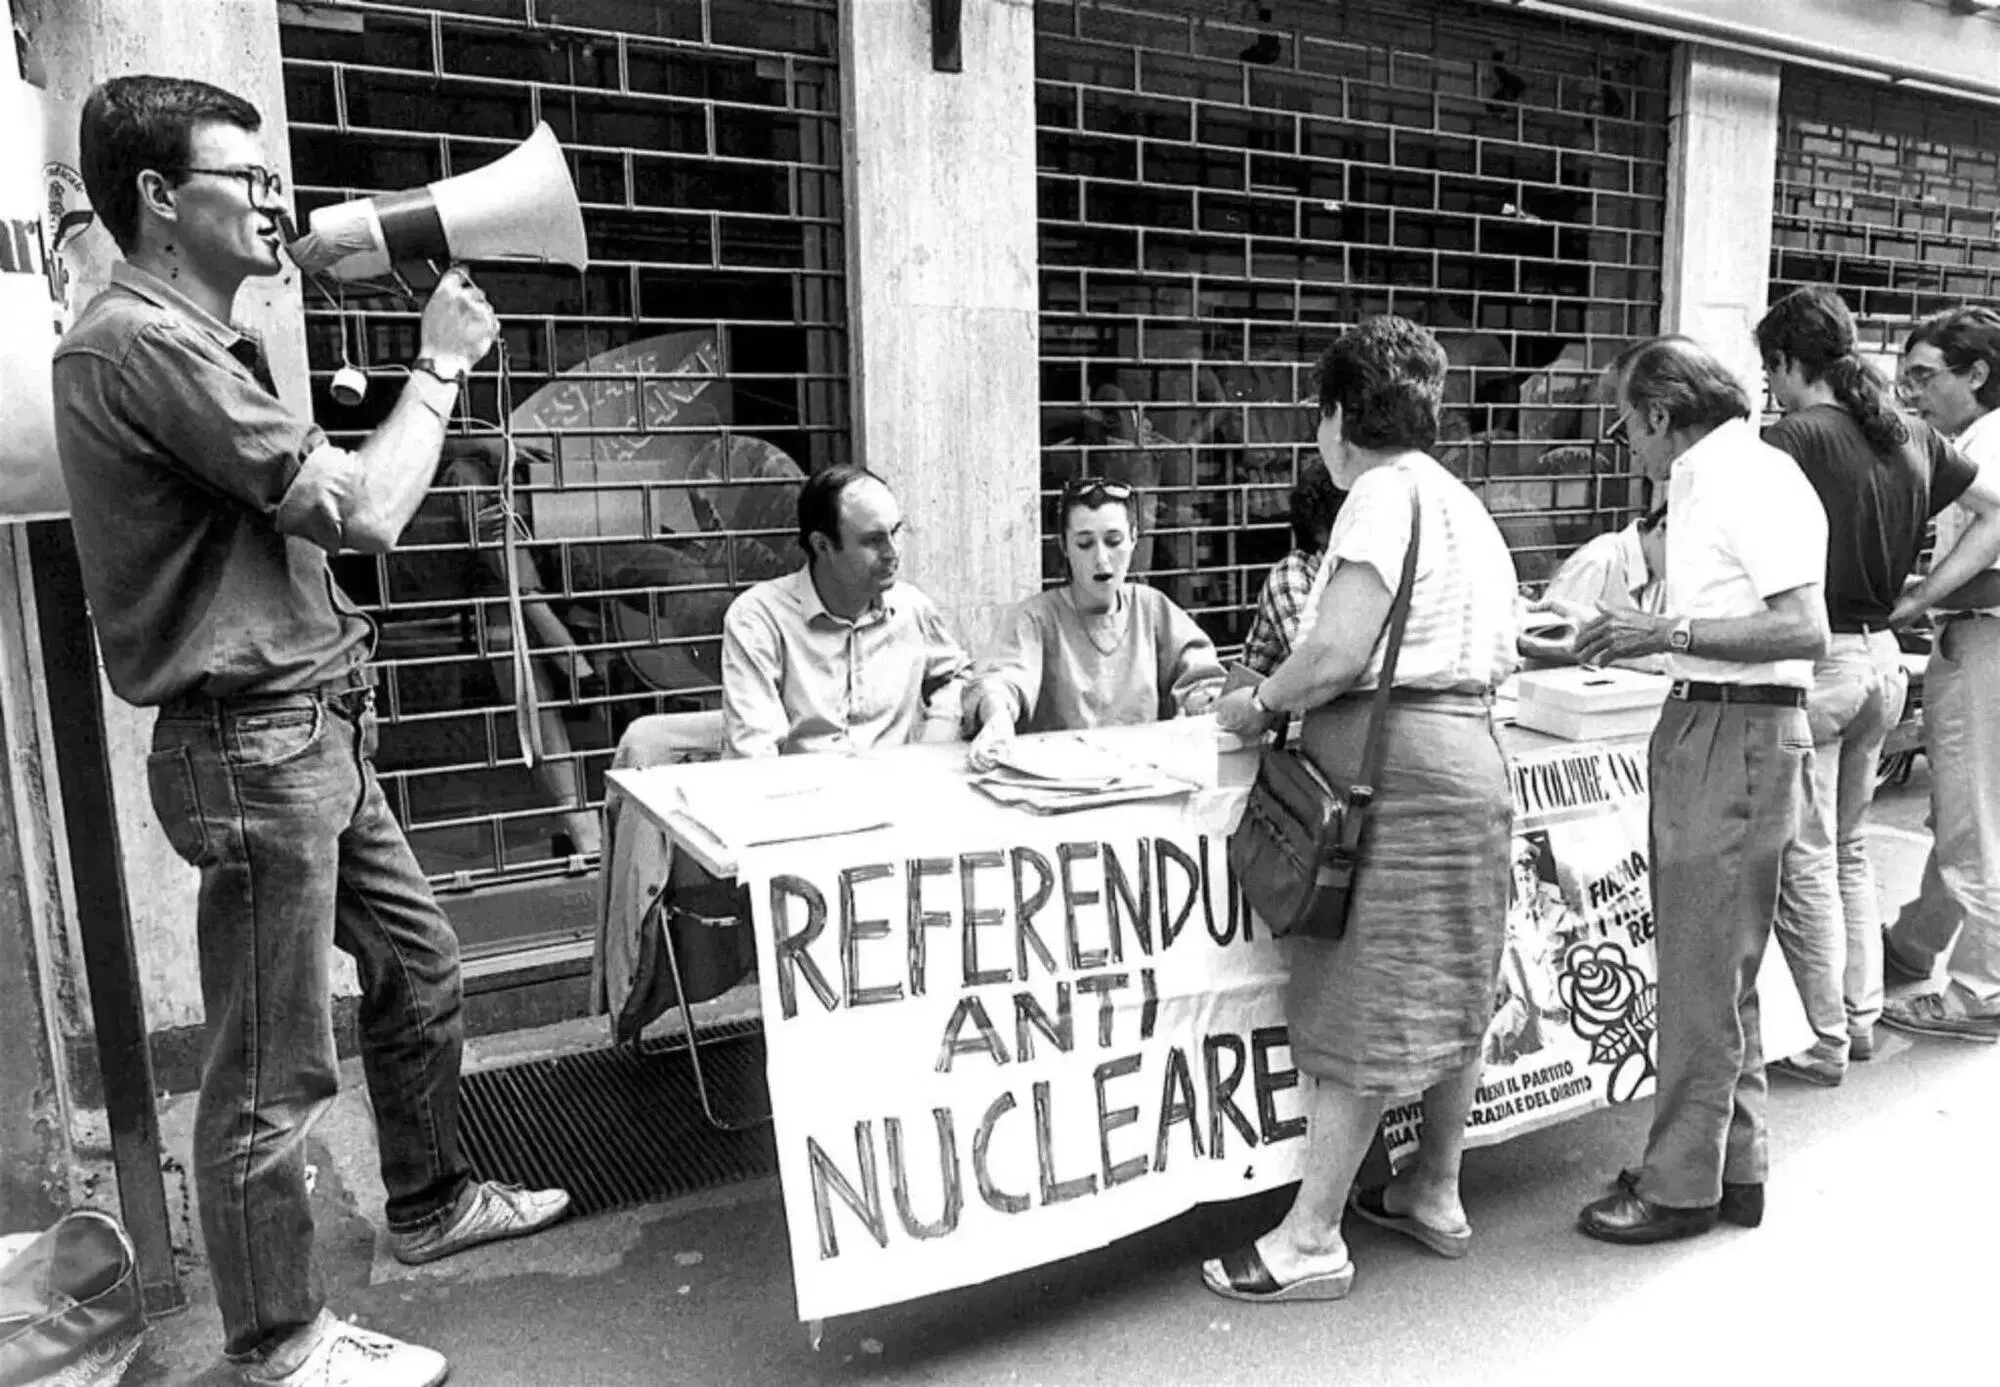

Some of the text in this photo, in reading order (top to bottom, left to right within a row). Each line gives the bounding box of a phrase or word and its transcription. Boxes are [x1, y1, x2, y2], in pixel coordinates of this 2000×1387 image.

[769, 834, 1254, 1021] REFERENDU
[934, 967, 1159, 1073] ANTI
[1465, 1101, 1515, 1127] RAZIA
[1521, 1060, 1573, 1091] PARTITO
[806, 1025, 1307, 1260] NUCLEARE
